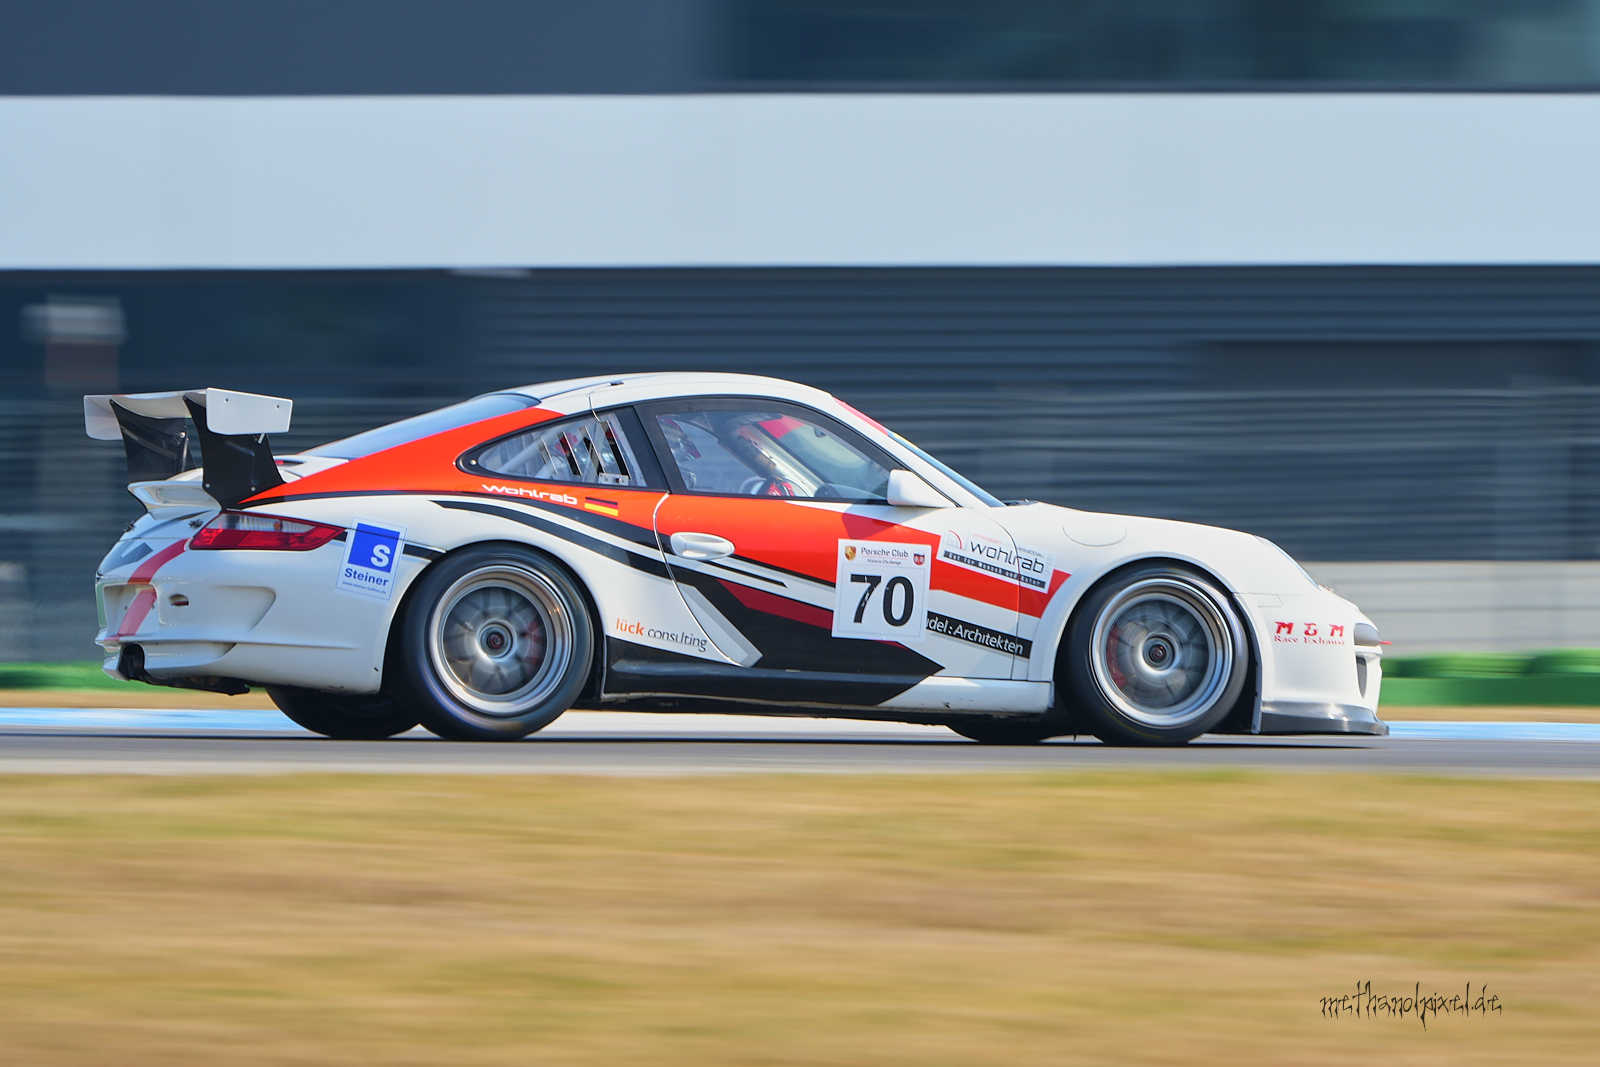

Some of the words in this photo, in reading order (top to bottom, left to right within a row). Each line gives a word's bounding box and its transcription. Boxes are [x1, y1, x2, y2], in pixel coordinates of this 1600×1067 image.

[371, 544, 391, 568] S
[861, 546, 891, 557] Porsche
[892, 548, 909, 558] Club
[970, 541, 1045, 574] wohlrab
[344, 567, 389, 587] Steiner
[850, 573, 914, 627] 70
[616, 618, 645, 636] lück
[647, 628, 708, 653] consulting
[1275, 621, 1294, 635] M
[1329, 624, 1345, 637] M
[1274, 635, 1299, 644] Race
[1304, 637, 1345, 646] Exhaust
